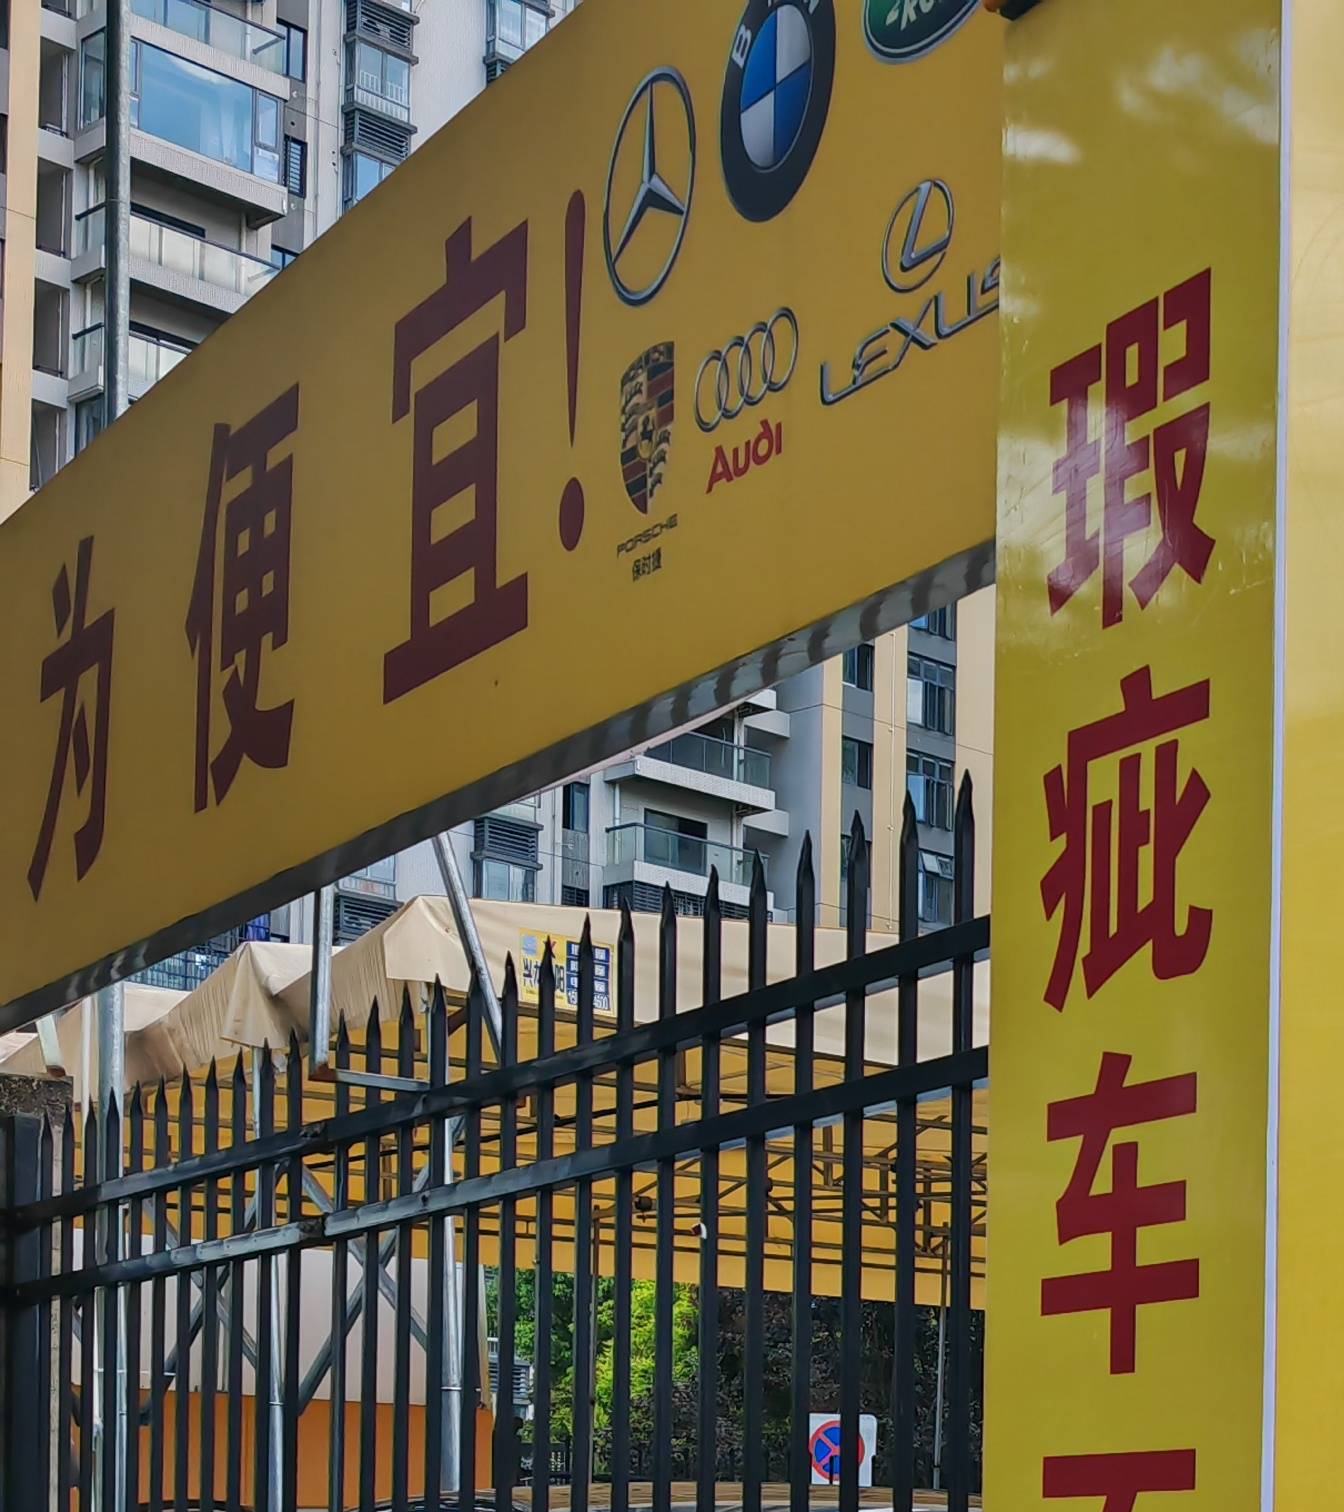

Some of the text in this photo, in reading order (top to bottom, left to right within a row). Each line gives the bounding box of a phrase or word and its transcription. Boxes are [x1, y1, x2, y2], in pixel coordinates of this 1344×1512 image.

[705, 418, 783, 495] Audi
[616, 512, 679, 559] PORSCHE
[632, 546, 663, 583] 保时捷
